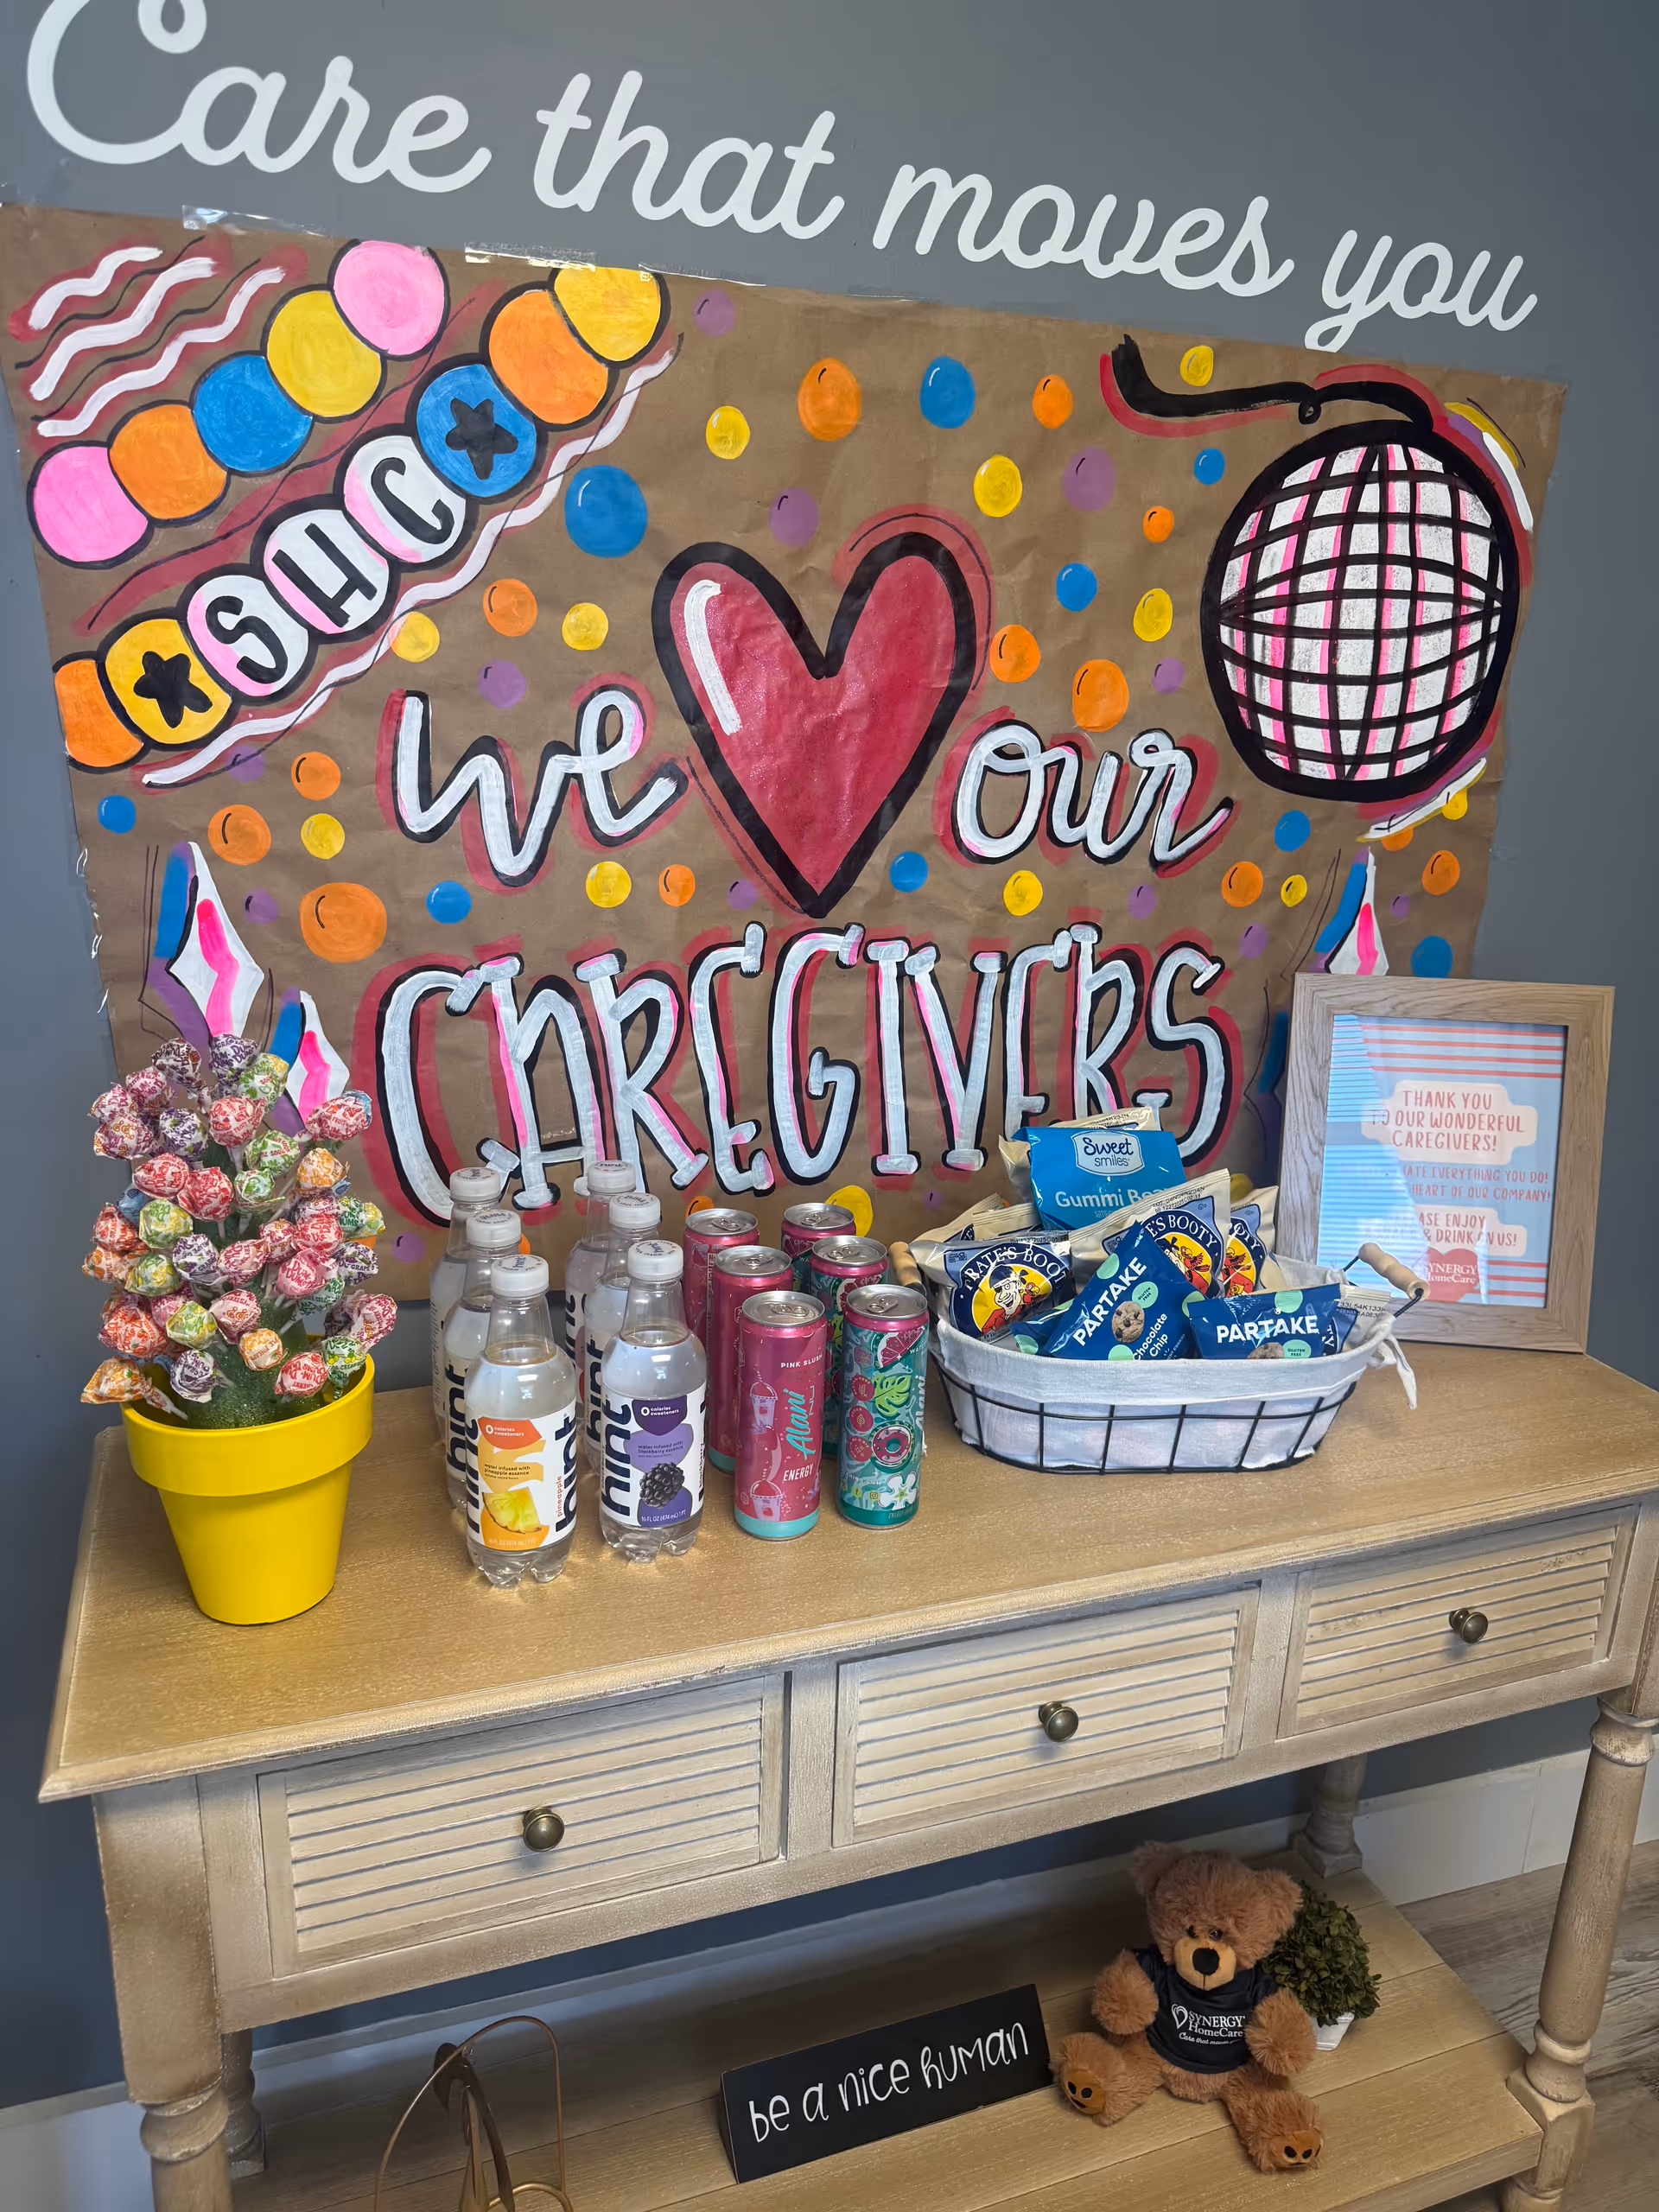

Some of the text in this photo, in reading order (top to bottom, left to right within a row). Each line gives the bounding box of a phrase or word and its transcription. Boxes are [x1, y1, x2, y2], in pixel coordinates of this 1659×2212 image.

[27, 0, 1538, 353] Care that moves you
[952, 719, 1236, 865] our
[376, 920, 1231, 1227] CAREGIVERS
[1402, 1090, 1492, 1110] THANK YOU
[1371, 1109, 1525, 1133] TO OUR WONDERFUL
[1083, 1137, 1135, 1156] Sweet
[1392, 1130, 1497, 1152] CAREGIVERS!
[1094, 1155, 1129, 1167] smiles
[1432, 1166, 1501, 1183] EVERYTHING
[1504, 1171, 1525, 1183] YOU
[1529, 1171, 1548, 1184] DO!
[1055, 1187, 1125, 1208] Gummi
[1412, 1184, 1551, 1203] HEART OF OUR COMPANY!
[1167, 1214, 1218, 1249] BOOTY
[1446, 1213, 1486, 1230] ENJOY
[1435, 1230, 1473, 1244] DRINK
[1497, 1233, 1517, 1247] US!
[1023, 1248, 1067, 1284] BOOT
[1073, 1257, 1147, 1347] PARTAKE
[1137, 1287, 1152, 1301] GLUTEN
[1133, 1313, 1167, 1361] Chocolate
[1217, 1315, 1320, 1344] PARTAKE
[1149, 1333, 1168, 1357] Chip
[803, 1354, 823, 1366] SLUSH
[783, 1388, 817, 1460] Alani
[601, 1397, 631, 1516] hint
[484, 1468, 508, 1477] pineapple
[783, 1463, 813, 1483] ENERGY
[1188, 2020, 1243, 2037] HomeCare
[1189, 2010, 1243, 2028] SYNERGY
[1179, 2032, 1196, 2043] Care
[748, 2022, 1030, 2143] be a nice human
